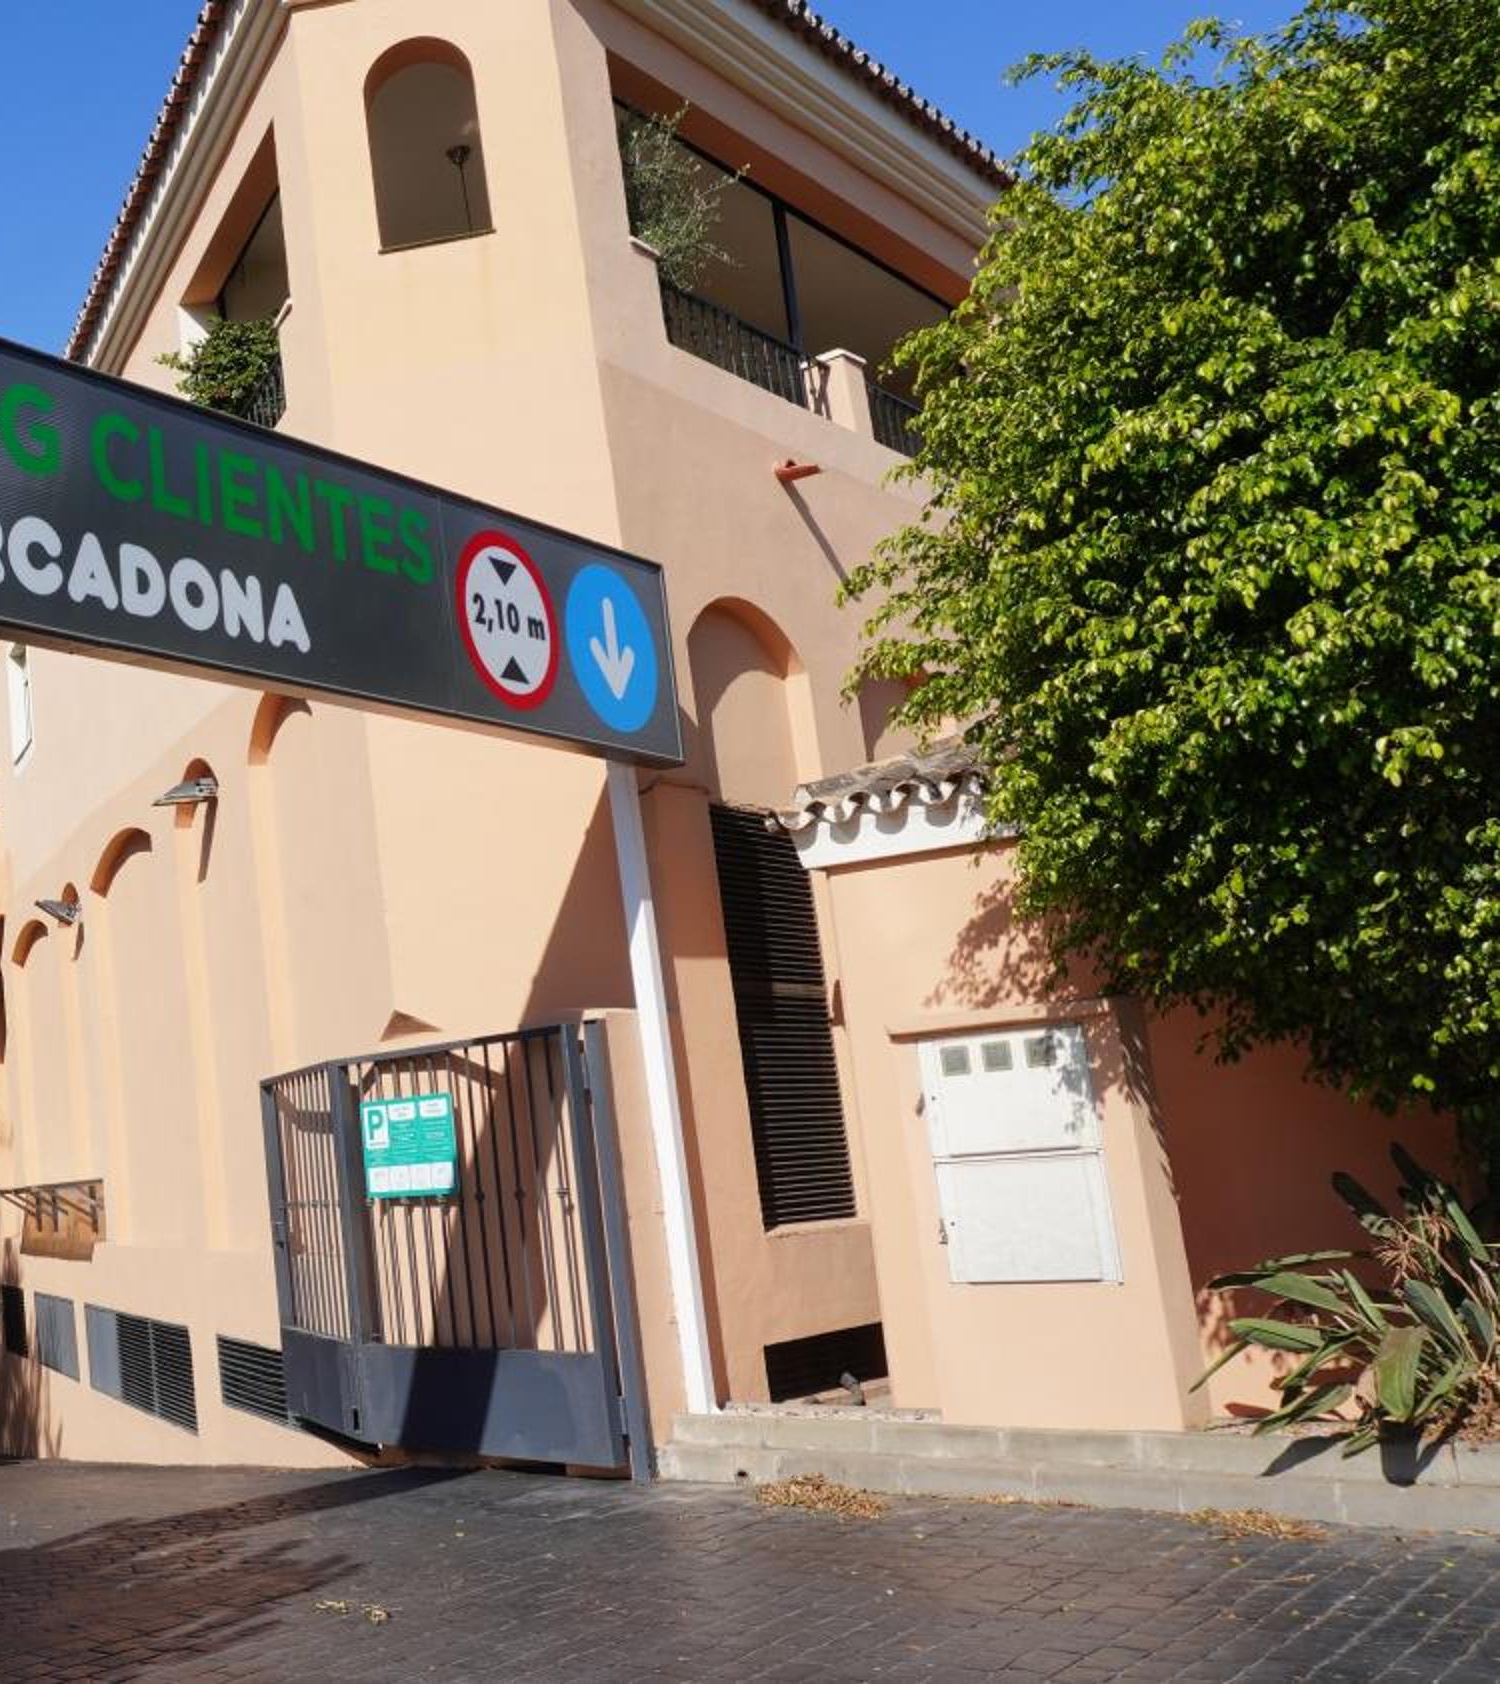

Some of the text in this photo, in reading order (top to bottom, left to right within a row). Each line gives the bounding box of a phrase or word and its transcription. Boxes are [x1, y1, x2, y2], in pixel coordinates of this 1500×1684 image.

[90, 411, 435, 586] CLIENTES
[473, 593, 546, 641] 2,10 m
[367, 1109, 384, 1141] P
